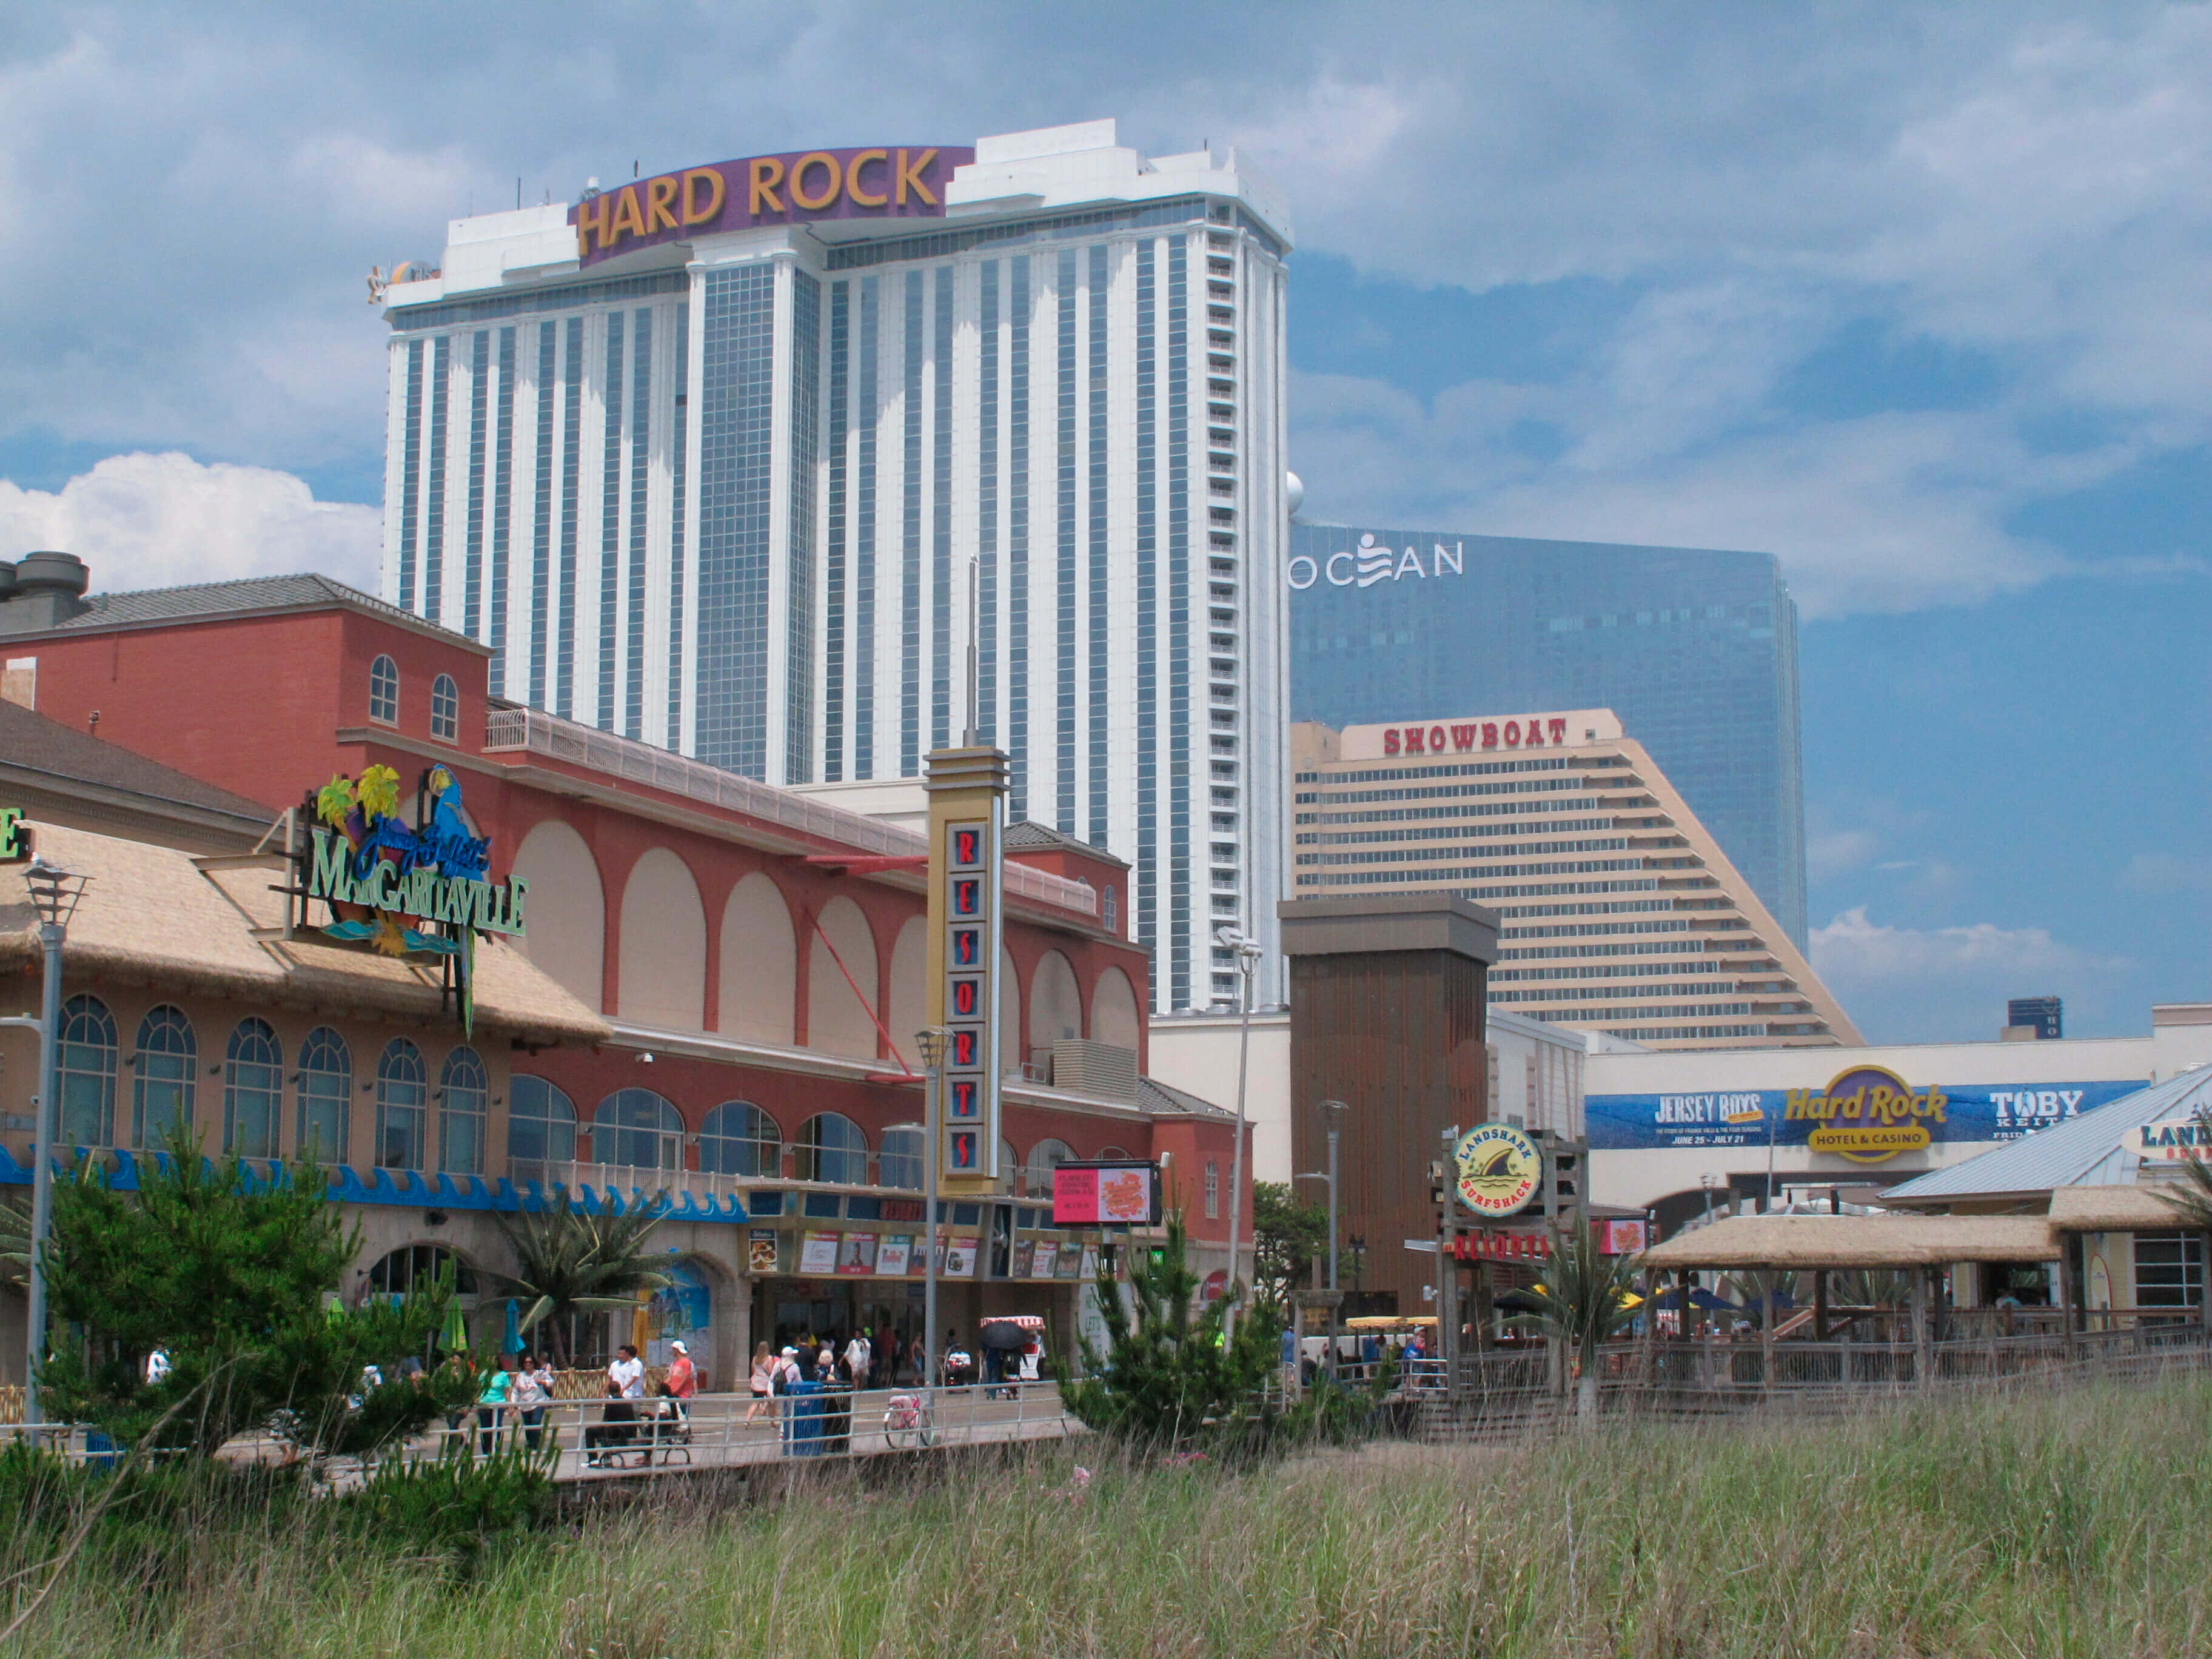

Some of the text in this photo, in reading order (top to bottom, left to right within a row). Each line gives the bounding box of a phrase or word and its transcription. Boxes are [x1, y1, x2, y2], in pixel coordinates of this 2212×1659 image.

[578, 149, 938, 256] HARD ROCK
[1288, 534, 1463, 589] OCEAN
[1384, 718, 1566, 754] SHOWBOAT
[309, 829, 529, 936] MARGARITAVILLE
[956, 832, 973, 1165] RESORTS
[1655, 1094, 1715, 1122] JERSEY
[1719, 1093, 1760, 1122] BOYS
[1785, 1084, 1948, 1125] Hard Rock
[1989, 1090, 2083, 1118] TOBY
[1996, 1117, 2076, 1127] KEIT
[1458, 1128, 1532, 1161] LANDSHARK
[1694, 1136, 1705, 1144] 25
[1712, 1135, 1732, 1144] JULY
[1734, 1134, 1744, 1144] 21
[1817, 1133, 1921, 1145] HOTEL & CASINO
[1455, 1235, 1549, 1260] RESORTS
